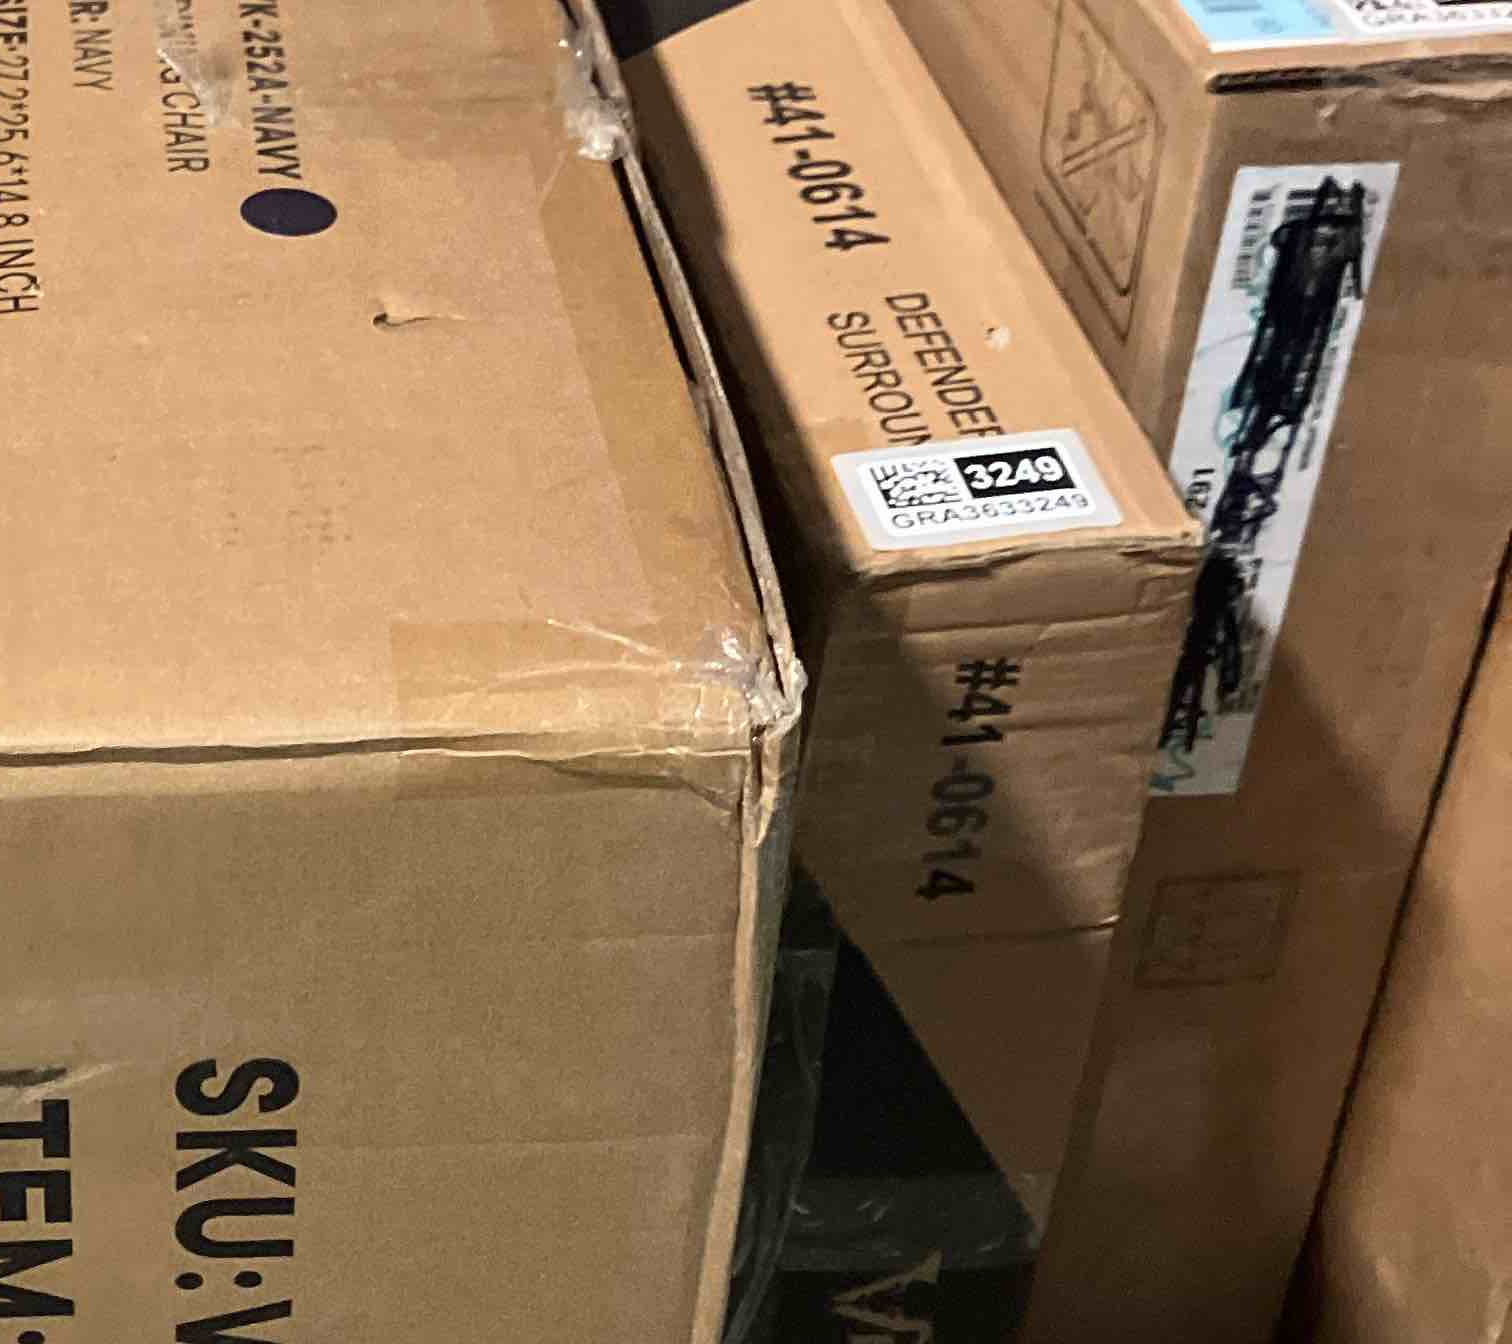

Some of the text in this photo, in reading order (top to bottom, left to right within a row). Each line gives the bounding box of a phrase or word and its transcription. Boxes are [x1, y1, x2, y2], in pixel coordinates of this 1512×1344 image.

[73, 29, 113, 92] NAVY
[162, 92, 209, 173] CHAIR
[746, 82, 891, 251] #41-0614
[963, 455, 1064, 490] 3249
[915, 660, 1020, 902] #41-0614
